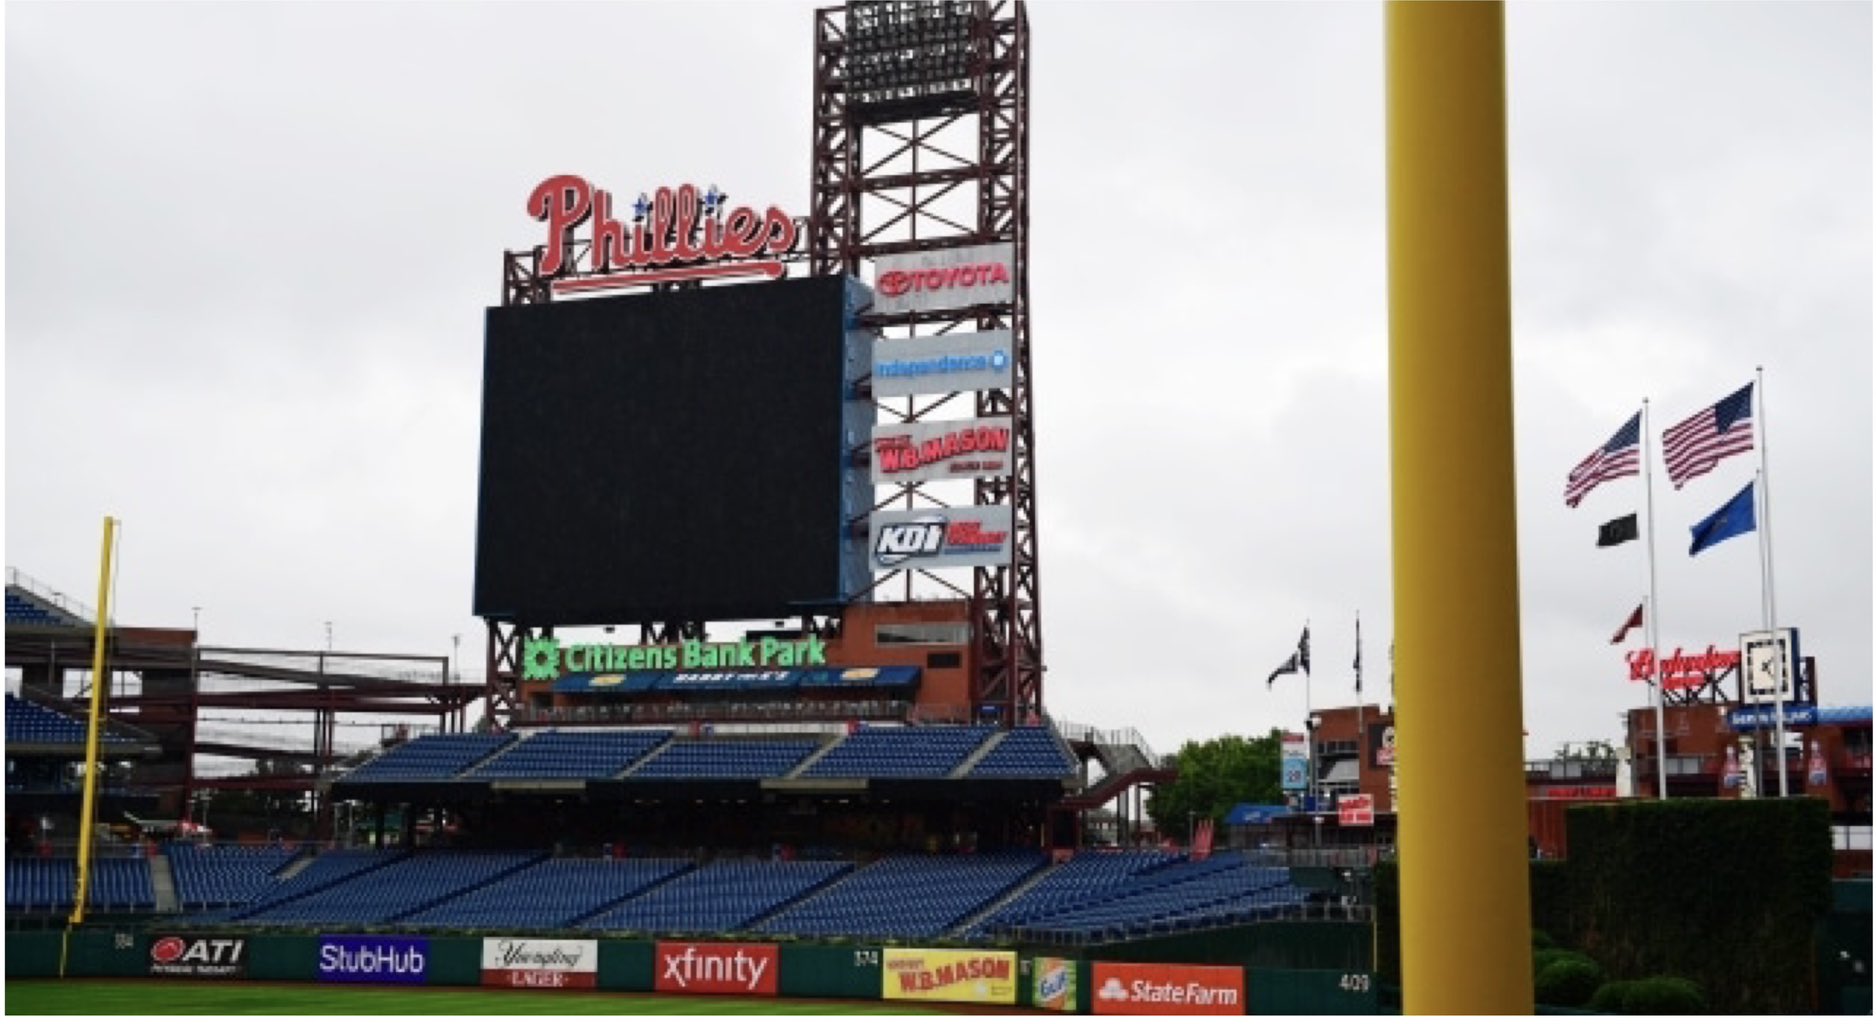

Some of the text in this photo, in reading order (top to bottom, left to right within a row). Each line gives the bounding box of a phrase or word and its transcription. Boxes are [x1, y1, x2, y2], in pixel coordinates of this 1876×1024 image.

[527, 173, 796, 276] Phillies
[911, 262, 1009, 291] TOYOTA
[565, 631, 827, 673] Citizens Bank Park
[182, 938, 245, 963] ATI
[320, 945, 425, 973] StubHub
[663, 946, 769, 990] xfinity
